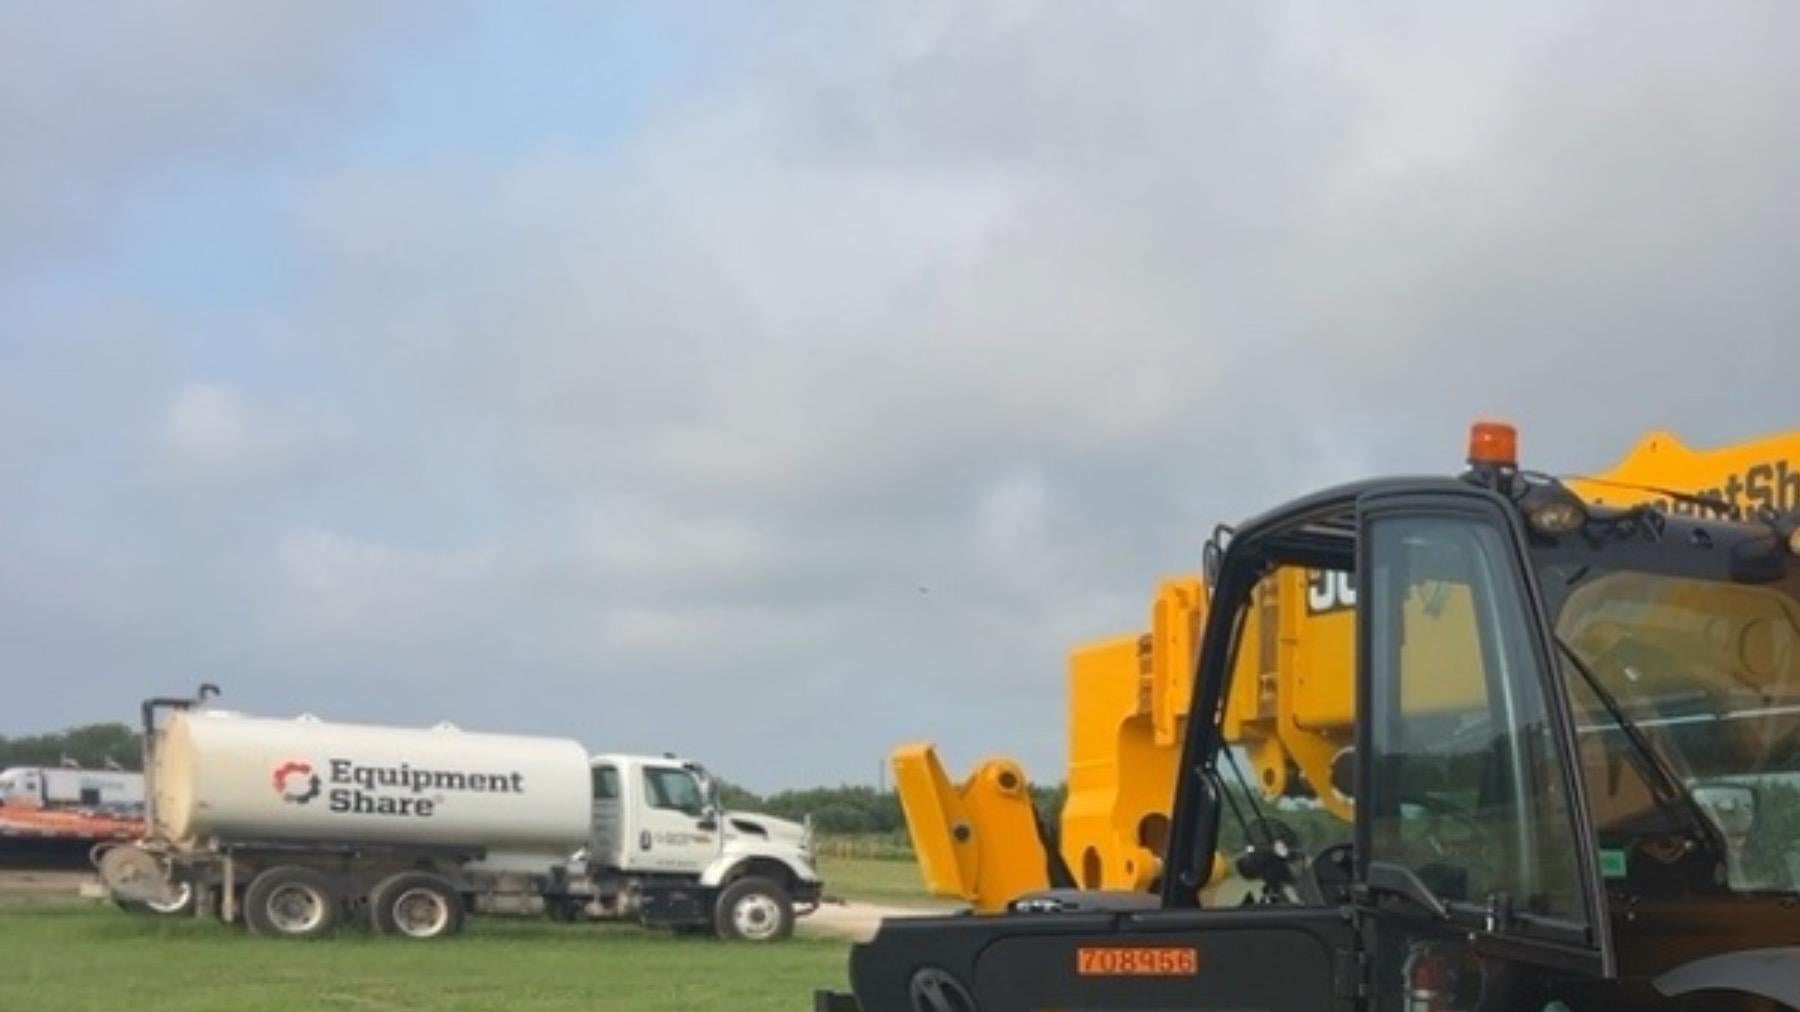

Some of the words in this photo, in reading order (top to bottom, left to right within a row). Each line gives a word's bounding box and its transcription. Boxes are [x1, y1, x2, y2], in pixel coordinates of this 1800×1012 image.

[329, 758, 525, 793] Equipment
[329, 788, 436, 817] Share
[1082, 947, 1194, 972] 708956
